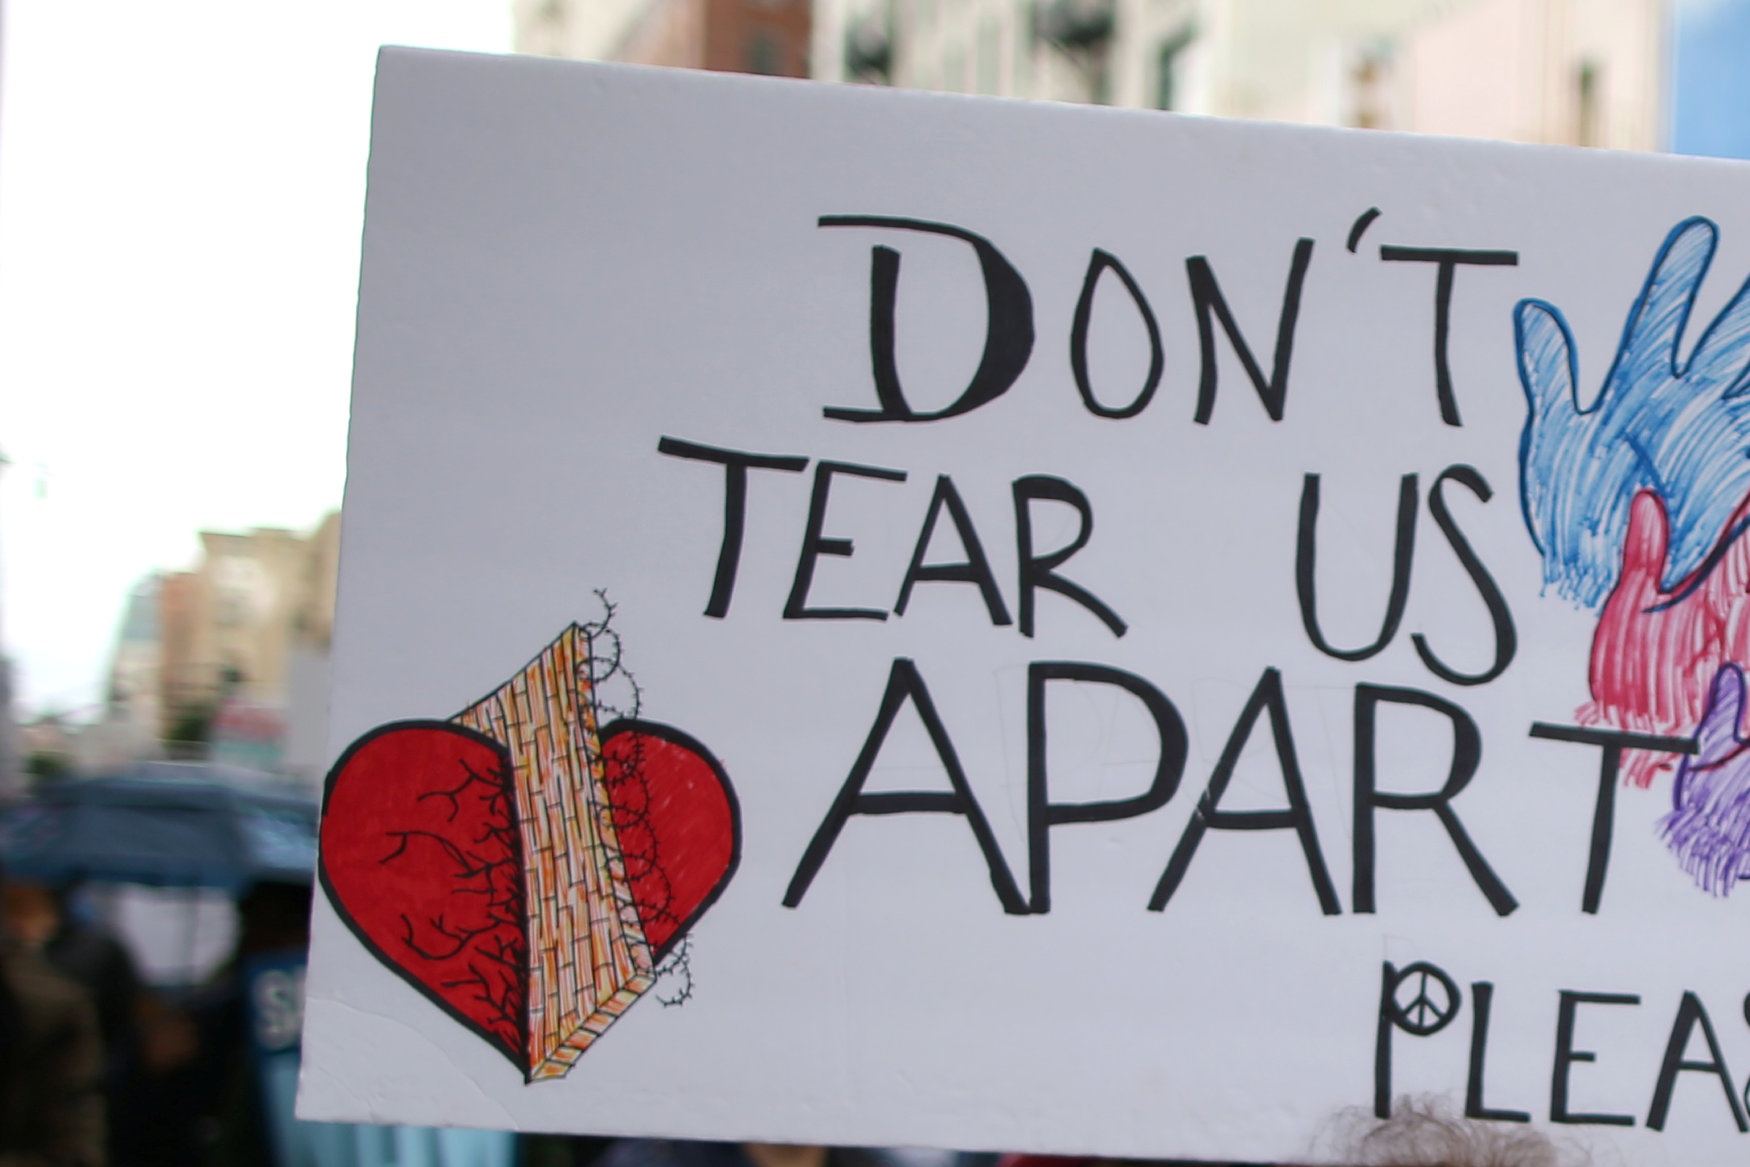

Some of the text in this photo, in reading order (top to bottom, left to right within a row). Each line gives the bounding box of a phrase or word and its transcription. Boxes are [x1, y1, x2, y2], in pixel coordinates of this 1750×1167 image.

[818, 207, 1519, 427] DON'T
[657, 435, 1518, 686] TEAR US
[781, 656, 1699, 914] APART
